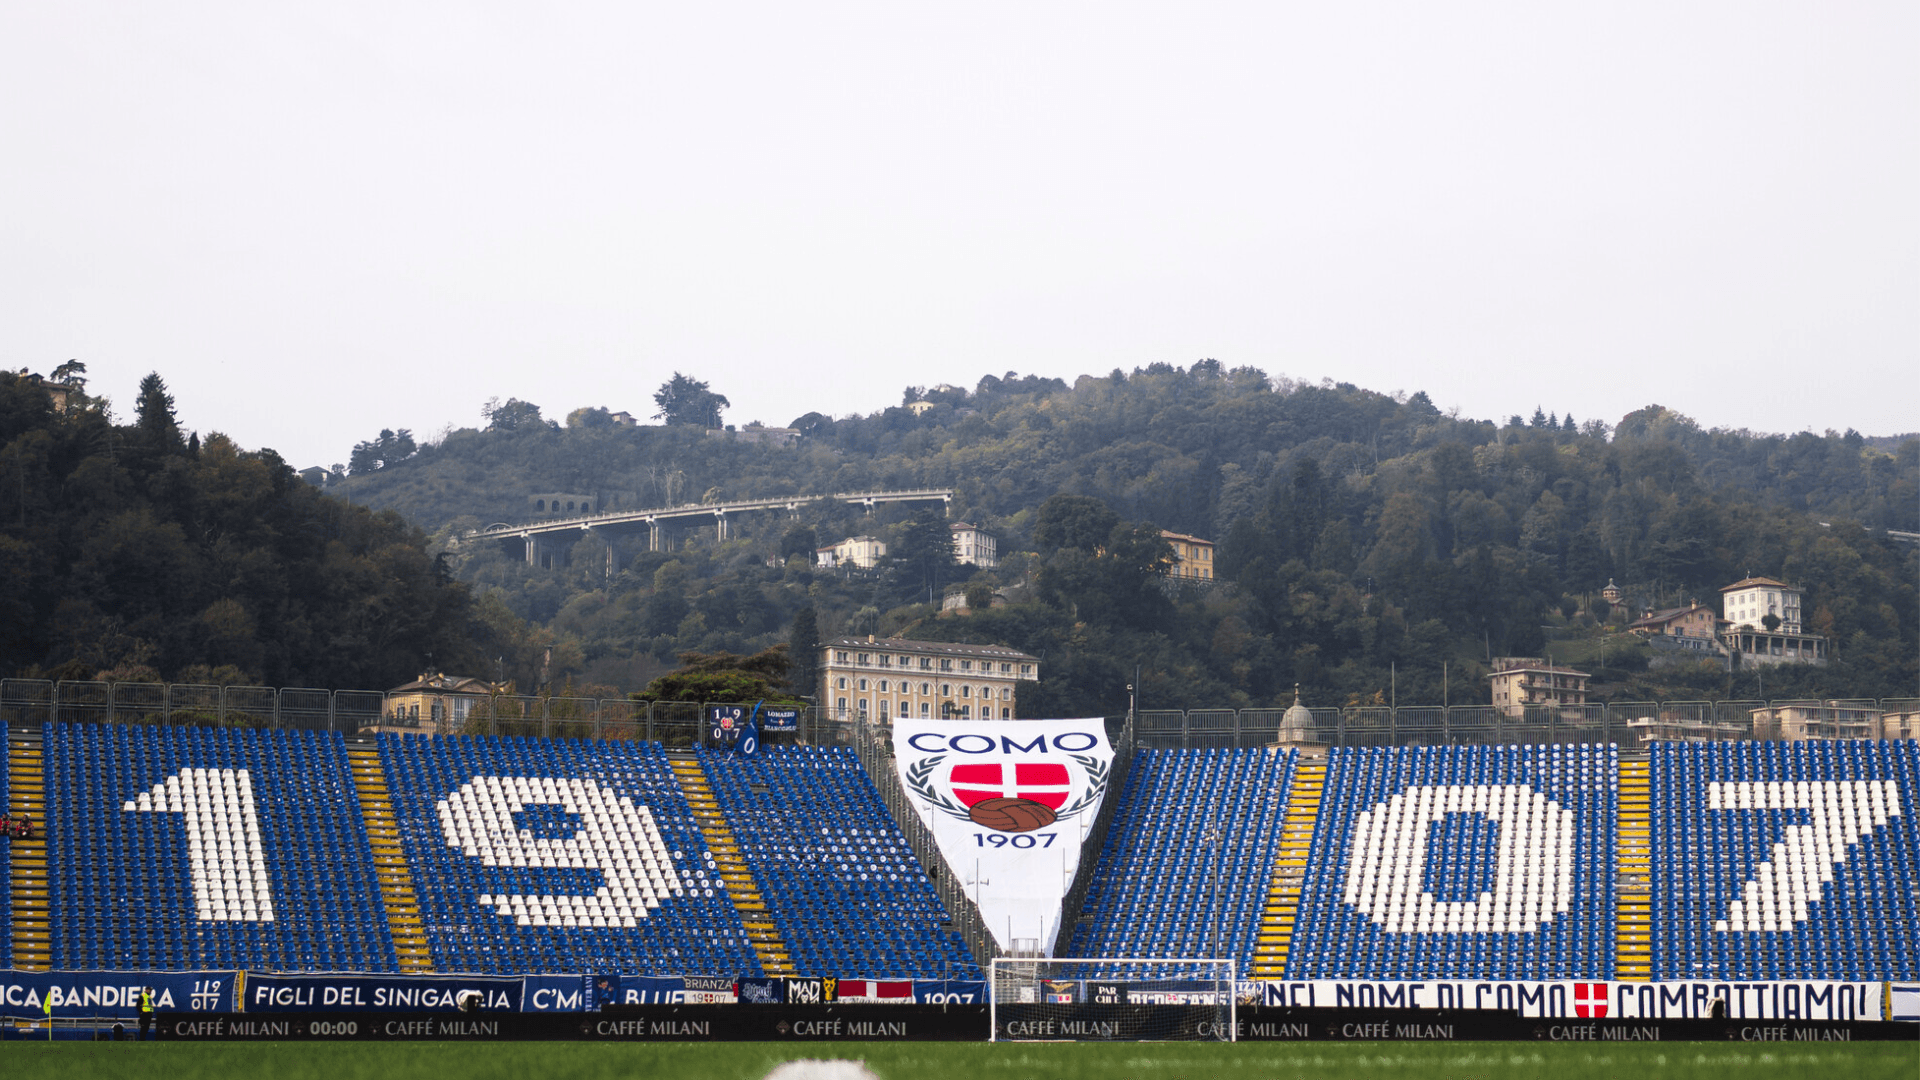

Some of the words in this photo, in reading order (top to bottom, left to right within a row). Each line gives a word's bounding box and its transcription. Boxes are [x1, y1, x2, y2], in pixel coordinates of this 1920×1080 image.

[907, 732, 1098, 754] COMO
[973, 833, 1058, 849] 1907
[685, 979, 733, 990] BRIANZA
[1098, 986, 1117, 995] PAR
[50, 985, 175, 1008] BANDIERA
[255, 986, 314, 1006] FIGLI
[323, 986, 366, 1006] DEL
[373, 988, 510, 1009] SINIGAIA
[532, 988, 582, 1009] C'M
[924, 992, 974, 1004] 1907
[176, 1018, 224, 1036] CAFFÉ
[229, 1021, 289, 1036] MILANI
[309, 1021, 358, 1035] 00:00
[385, 1018, 433, 1035] CAFFÉ
[439, 1021, 498, 1035] MILANI
[597, 1018, 645, 1035] CAFFÉ
[650, 1021, 710, 1035] MILANI
[793, 1018, 842, 1036] CAFFÉ
[847, 1021, 906, 1036] MILANI
[1007, 1018, 1055, 1035] CAFFÉ
[1060, 1021, 1119, 1035] MILANI
[1250, 1023, 1308, 1037] MILANI
[1342, 1020, 1389, 1038] CAFFÉ
[1395, 1024, 1454, 1039] MILANI
[1550, 1023, 1597, 1040] CAFFÉ
[1602, 1026, 1659, 1040] MILANI
[1741, 1024, 1788, 1041] CAFFÉ
[1793, 1028, 1850, 1041] MILANI
